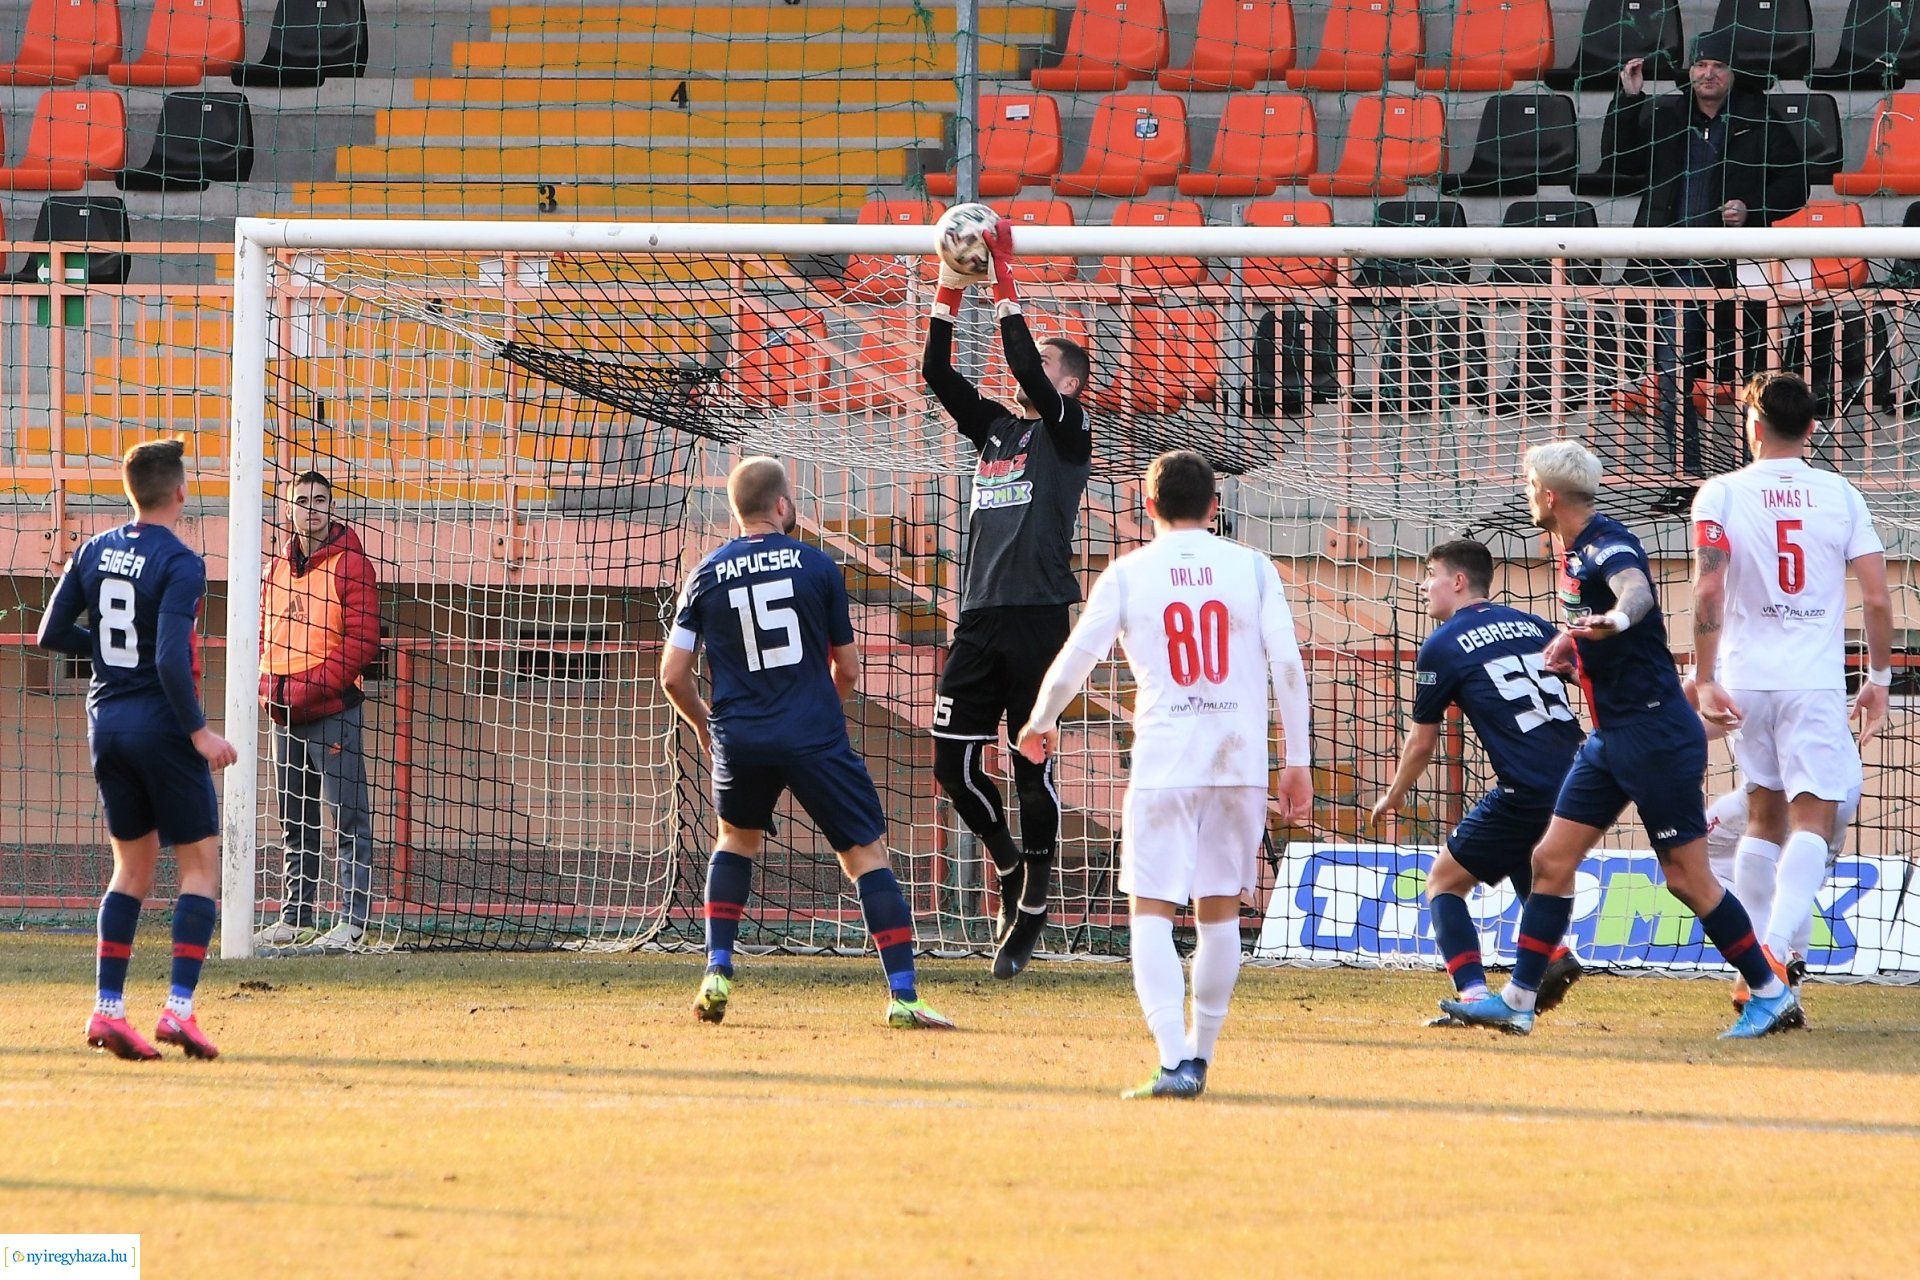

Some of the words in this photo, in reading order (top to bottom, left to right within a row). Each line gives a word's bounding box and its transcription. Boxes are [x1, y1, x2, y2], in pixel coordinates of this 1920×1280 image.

[670, 81, 689, 109] 4
[539, 184, 558, 213] 3
[1761, 486, 1802, 508] TAMÁS
[1806, 489, 1818, 508] L.
[98, 547, 146, 579] SIGÉR
[715, 549, 803, 583] PAPUCSEK
[1776, 519, 1806, 595] 5
[1170, 566, 1214, 587] DRLJO
[98, 577, 140, 669] 8
[728, 577, 804, 672] 15
[1789, 608, 1826, 618] PALAZZO
[1163, 599, 1230, 687] 80
[934, 692, 954, 727] 5
[1203, 702, 1239, 711] PALAZZO
[1483, 652, 1576, 734] 55
